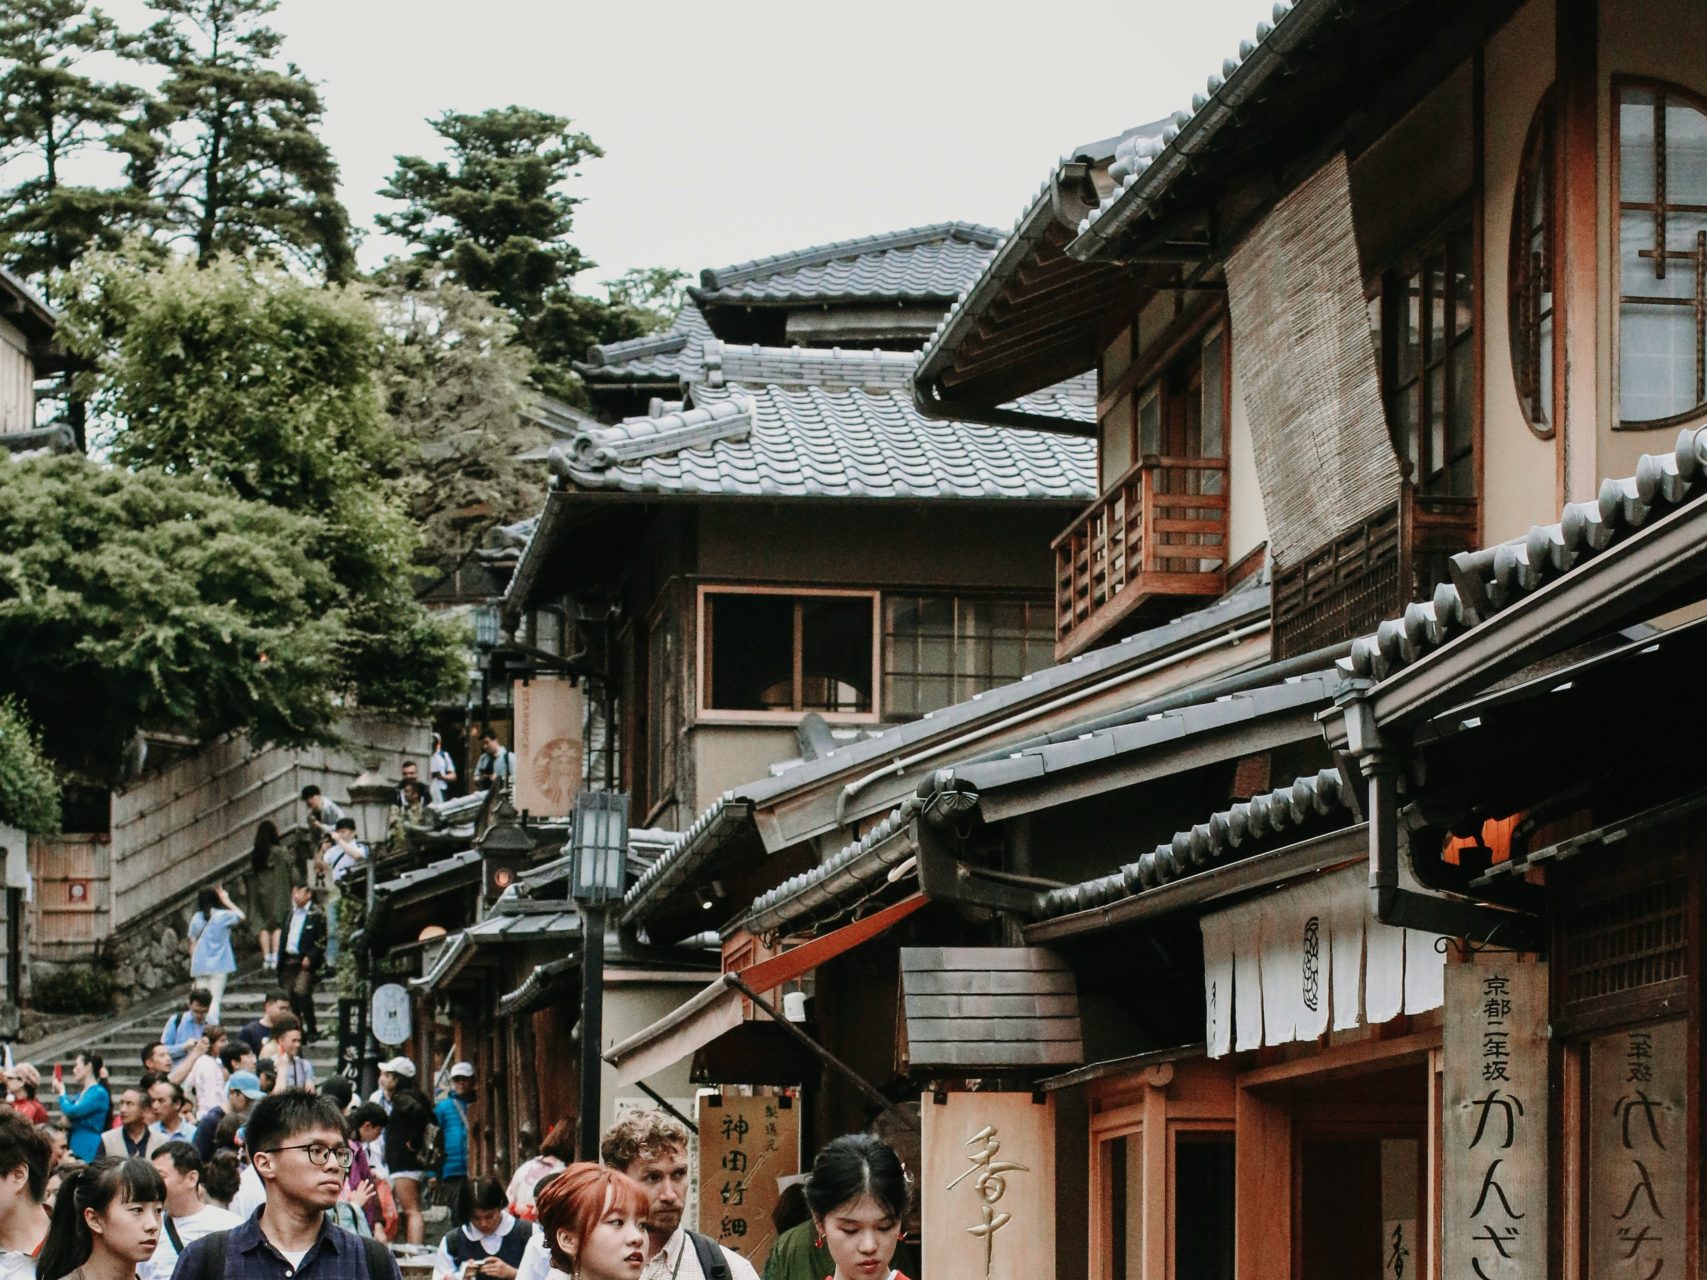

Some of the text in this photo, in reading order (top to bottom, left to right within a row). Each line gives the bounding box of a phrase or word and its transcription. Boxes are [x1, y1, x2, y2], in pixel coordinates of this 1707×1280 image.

[1482, 975, 1511, 1082] 京都二年坂
[719, 1114, 748, 1251] 神田竹細
